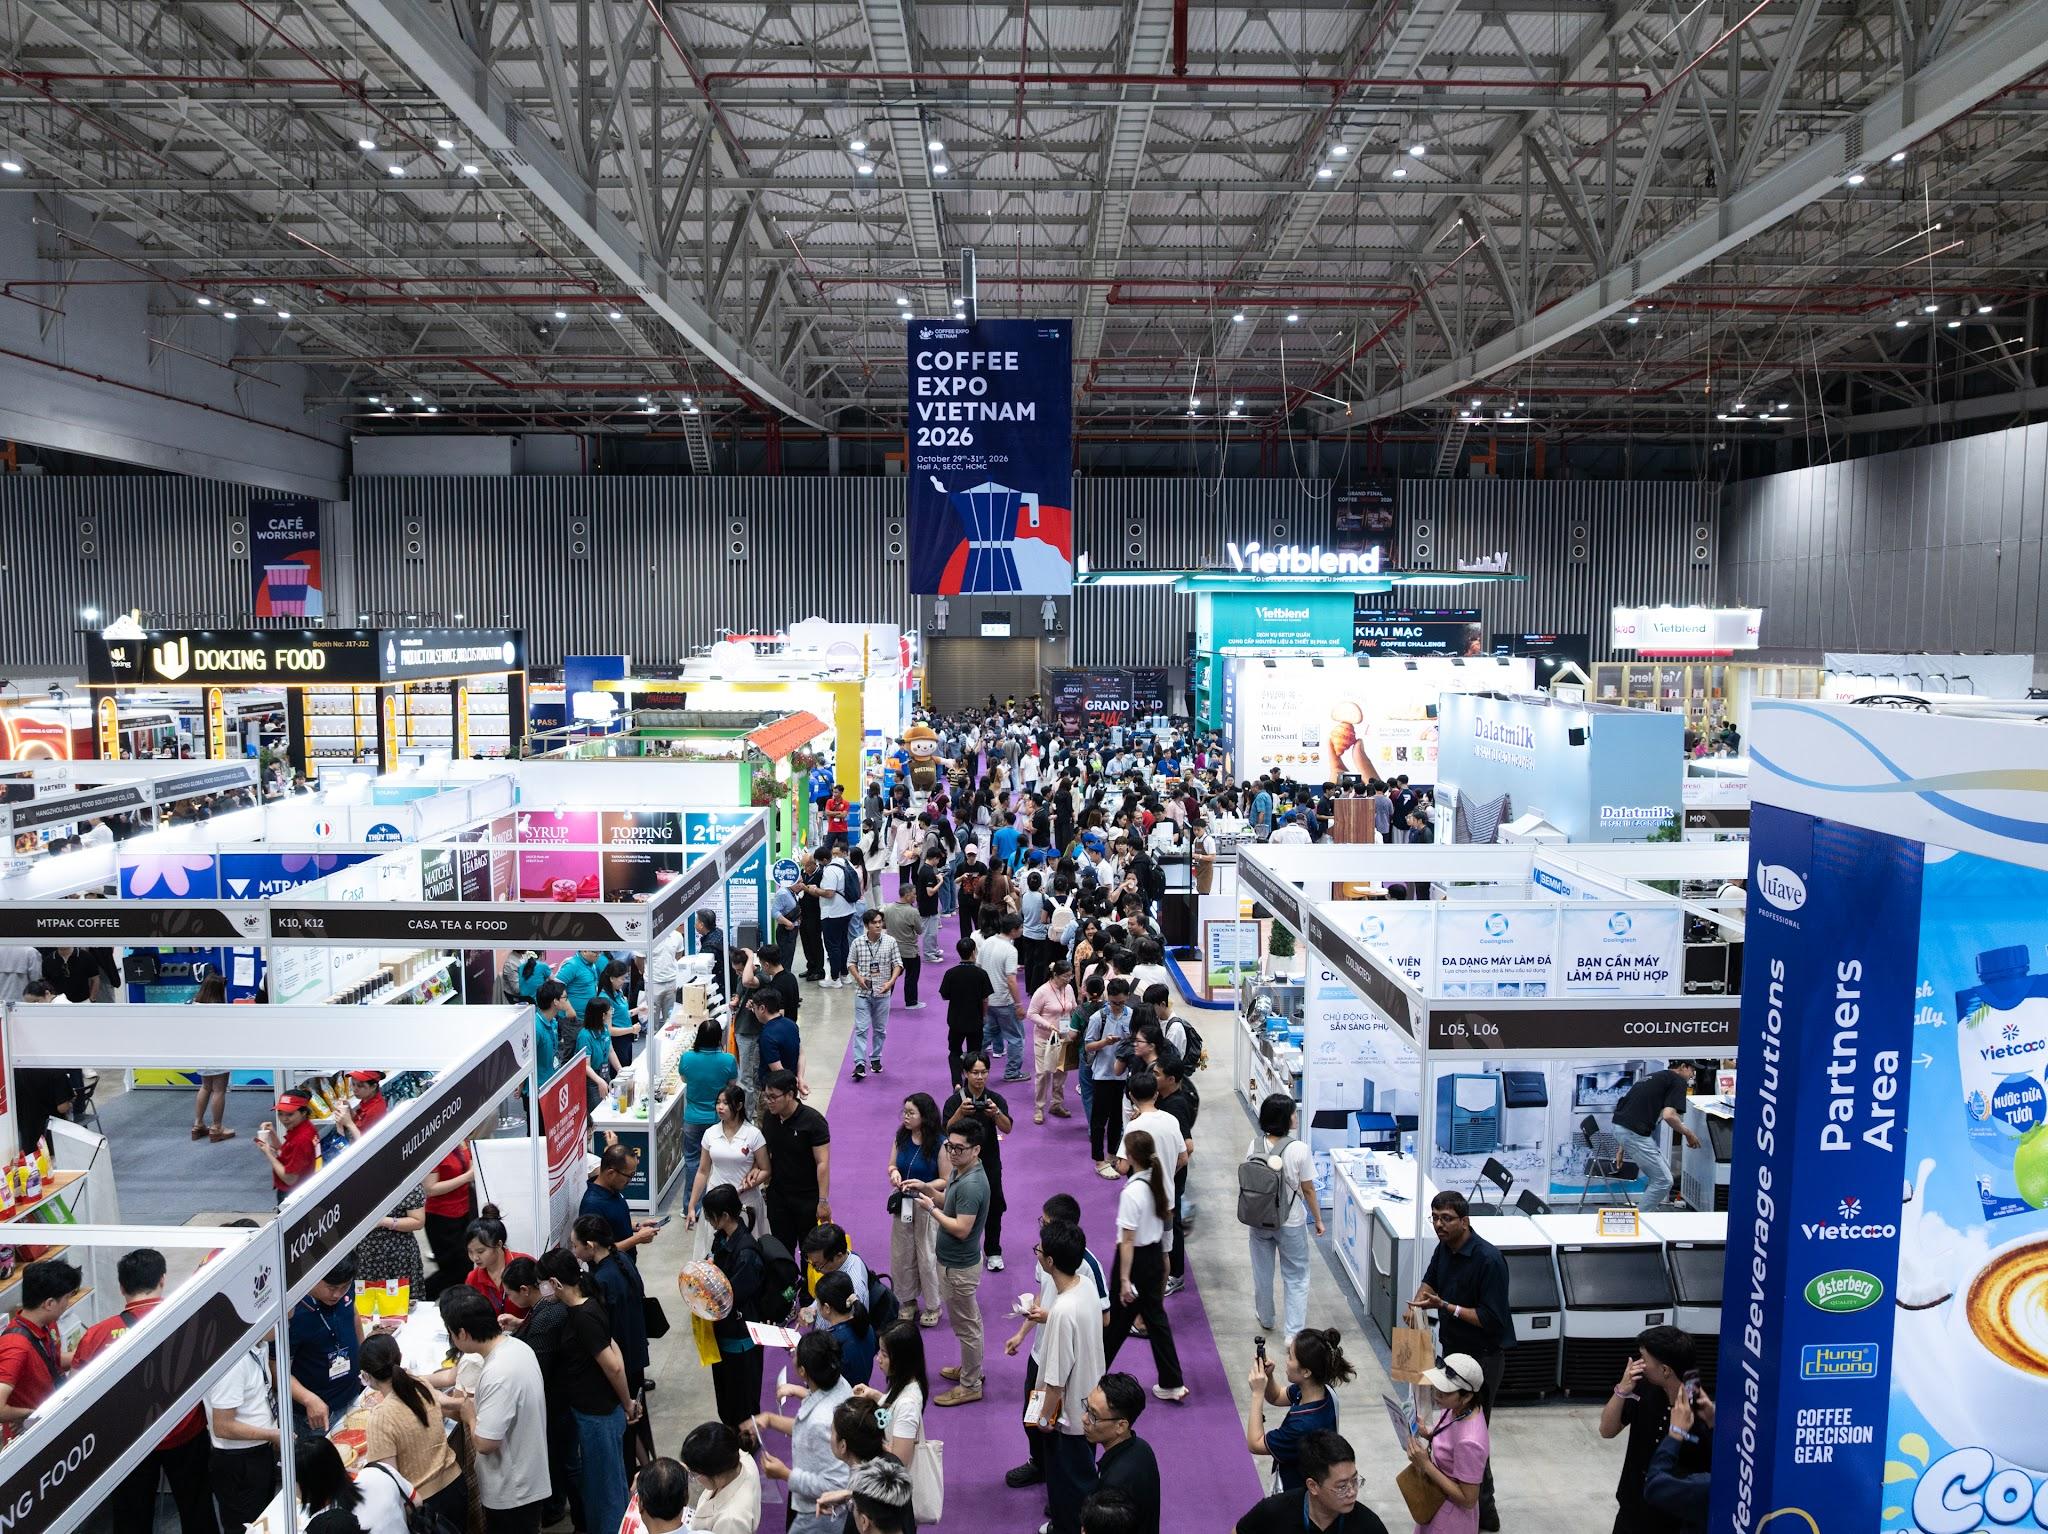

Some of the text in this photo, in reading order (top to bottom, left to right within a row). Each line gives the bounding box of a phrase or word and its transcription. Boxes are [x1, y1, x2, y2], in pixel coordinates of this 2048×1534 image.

[916, 351, 1018, 370] COFFEE
[918, 376, 988, 396] EXPO
[916, 402, 1036, 421] VIETNAM
[917, 427, 974, 446] 2026
[268, 517, 304, 530] CAFÉ
[1227, 542, 1379, 573] Vietblend
[1256, 607, 1309, 618] Vietblend
[1355, 627, 1422, 638] KHAI MẠC
[1654, 624, 1706, 633] Vietblend
[195, 650, 325, 670] DOKING FOOD
[1085, 700, 1130, 711] GRAND
[1261, 724, 1282, 732] Mini
[1261, 732, 1298, 740] croissant
[1475, 716, 1534, 749] Dalatmilk
[40, 784, 66, 792] PARTNERS
[36, 808, 62, 817] HANGZHOU
[63, 804, 81, 812] GLOBAL
[95, 797, 118, 806] SOLUTIONS
[1601, 806, 1674, 819] Dalatmilk
[525, 826, 569, 838] SYRUP
[611, 827, 672, 839] TOPPING
[693, 825, 716, 841] 21
[424, 862, 453, 885] MATCHA
[424, 879, 454, 900] POWDER
[37, 919, 119, 928] MTPAK COFFEE
[279, 918, 323, 929] K10, K12
[408, 920, 508, 930] CASA TEA & FOOD
[1758, 907, 1800, 929] PROFESSIONAL
[1398, 956, 1421, 966] VIÊN
[1460, 958, 1488, 967] DẠNG
[1491, 955, 1512, 965] MÁY
[1514, 955, 1534, 964] LÀM
[1537, 955, 1552, 964] ĐÁ
[1577, 954, 1659, 971] BẠN CẦN MÁY
[1567, 969, 1669, 983] LÀM ĐÁ PHÙ HỢP
[1916, 980, 1934, 997] sh
[1323, 1012, 1368, 1022] CHỦ ĐỘNG
[1348, 1022, 1370, 1030] SÀNG
[1440, 1024, 1499, 1037] L05, L06
[1624, 1021, 1729, 1034] COOLINGTECH
[1820, 959, 1863, 1152] Partners
[1981, 1038, 2045, 1061] Vietcoco
[1862, 1051, 1899, 1153] Area
[2005, 1107, 2033, 1125] TƯƠI
[401, 1097, 462, 1160] HUILIANG FOOD
[290, 1204, 341, 1264] K06-K08
[1801, 1220, 1896, 1241] Vietcoco
[1732, 957, 1785, 1534] fessional Beverage Solutions
[1817, 1276, 1873, 1299] Østerberg
[1817, 1349, 1862, 1362] Hung
[1806, 1361, 1872, 1375] Chuong
[1797, 1408, 1852, 1426] COFFEE
[1796, 1426, 1873, 1445] PRECISION
[1794, 1446, 1833, 1464] GEAR
[0, 1433, 96, 1530] NG FOOD
